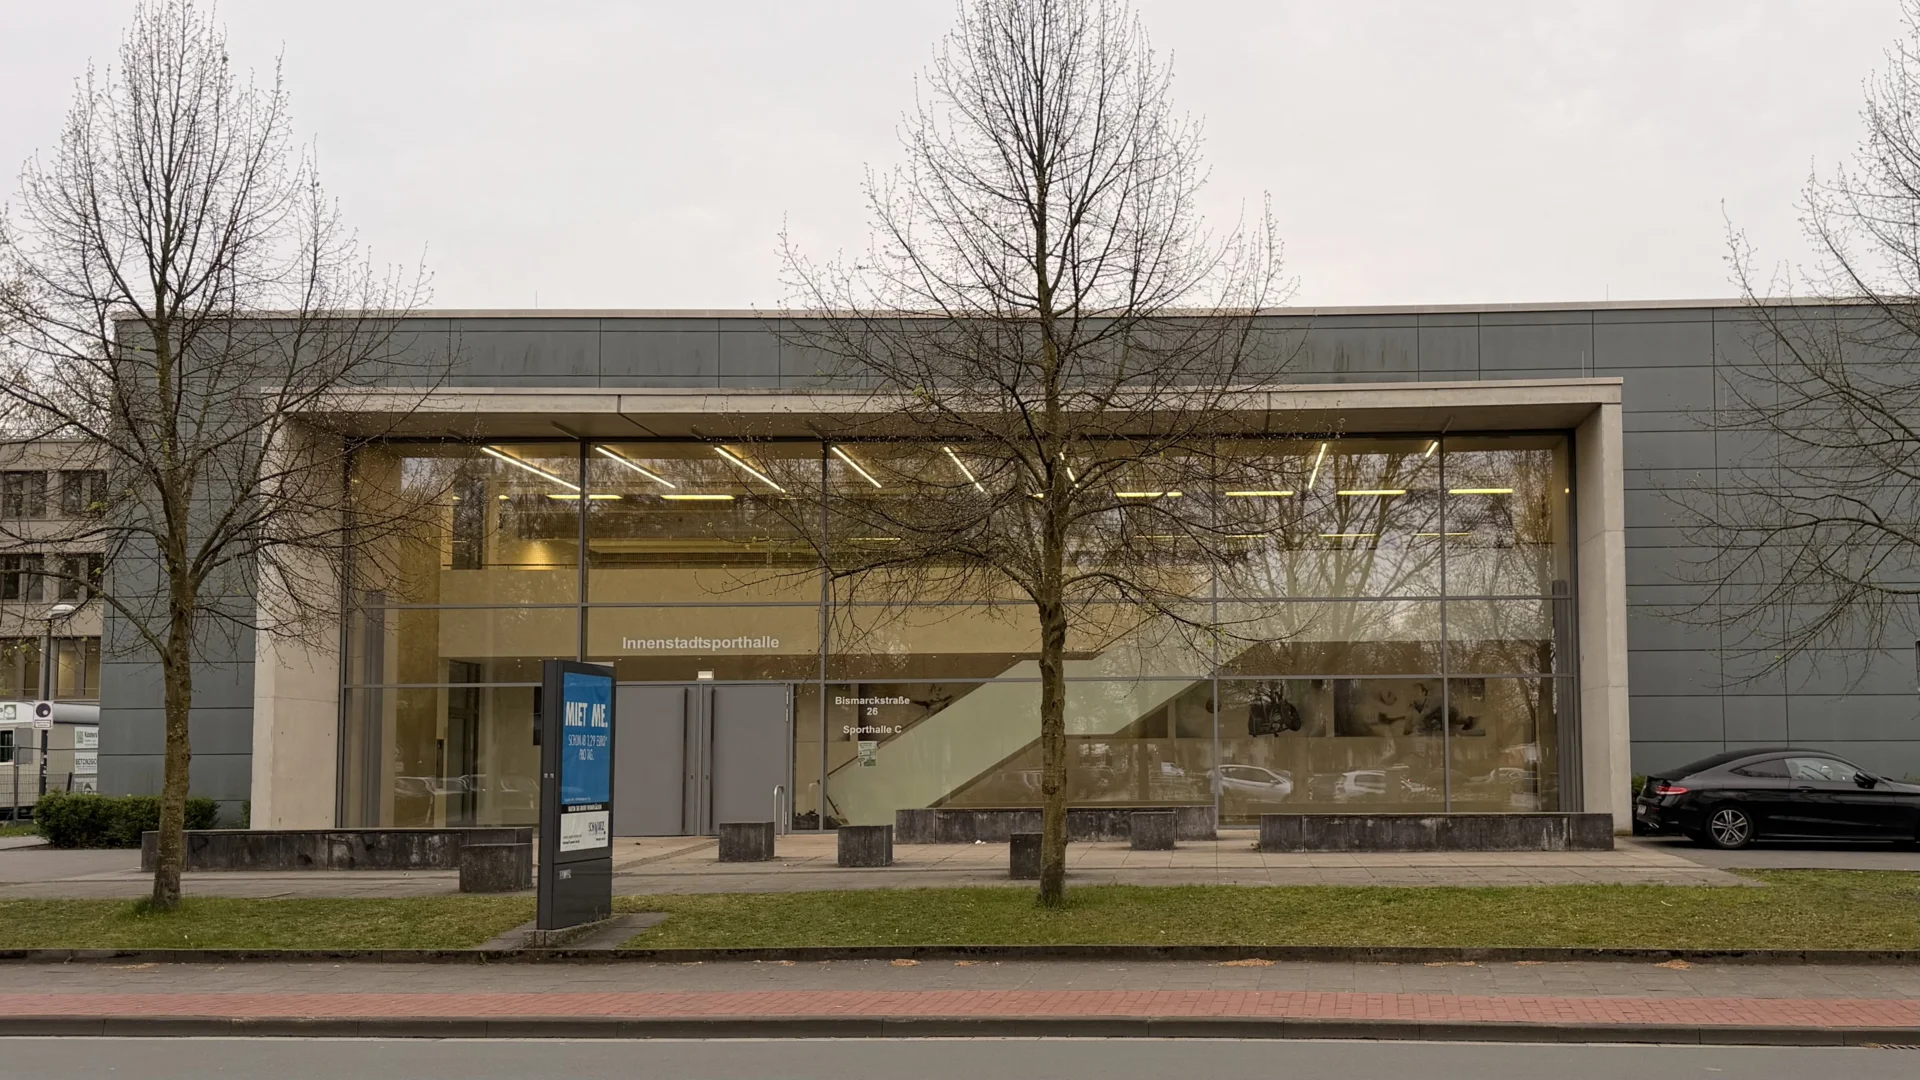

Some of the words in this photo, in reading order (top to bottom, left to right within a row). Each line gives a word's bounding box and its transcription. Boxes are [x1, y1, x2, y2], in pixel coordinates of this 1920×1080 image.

[622, 636, 780, 651] Innenstadtsporthalle
[835, 696, 911, 705] Bismarckstraße
[565, 701, 588, 726] MIET
[591, 703, 609, 728] ME.
[866, 707, 879, 716] 26
[843, 725, 892, 735] Sporthalle
[894, 725, 902, 734] C
